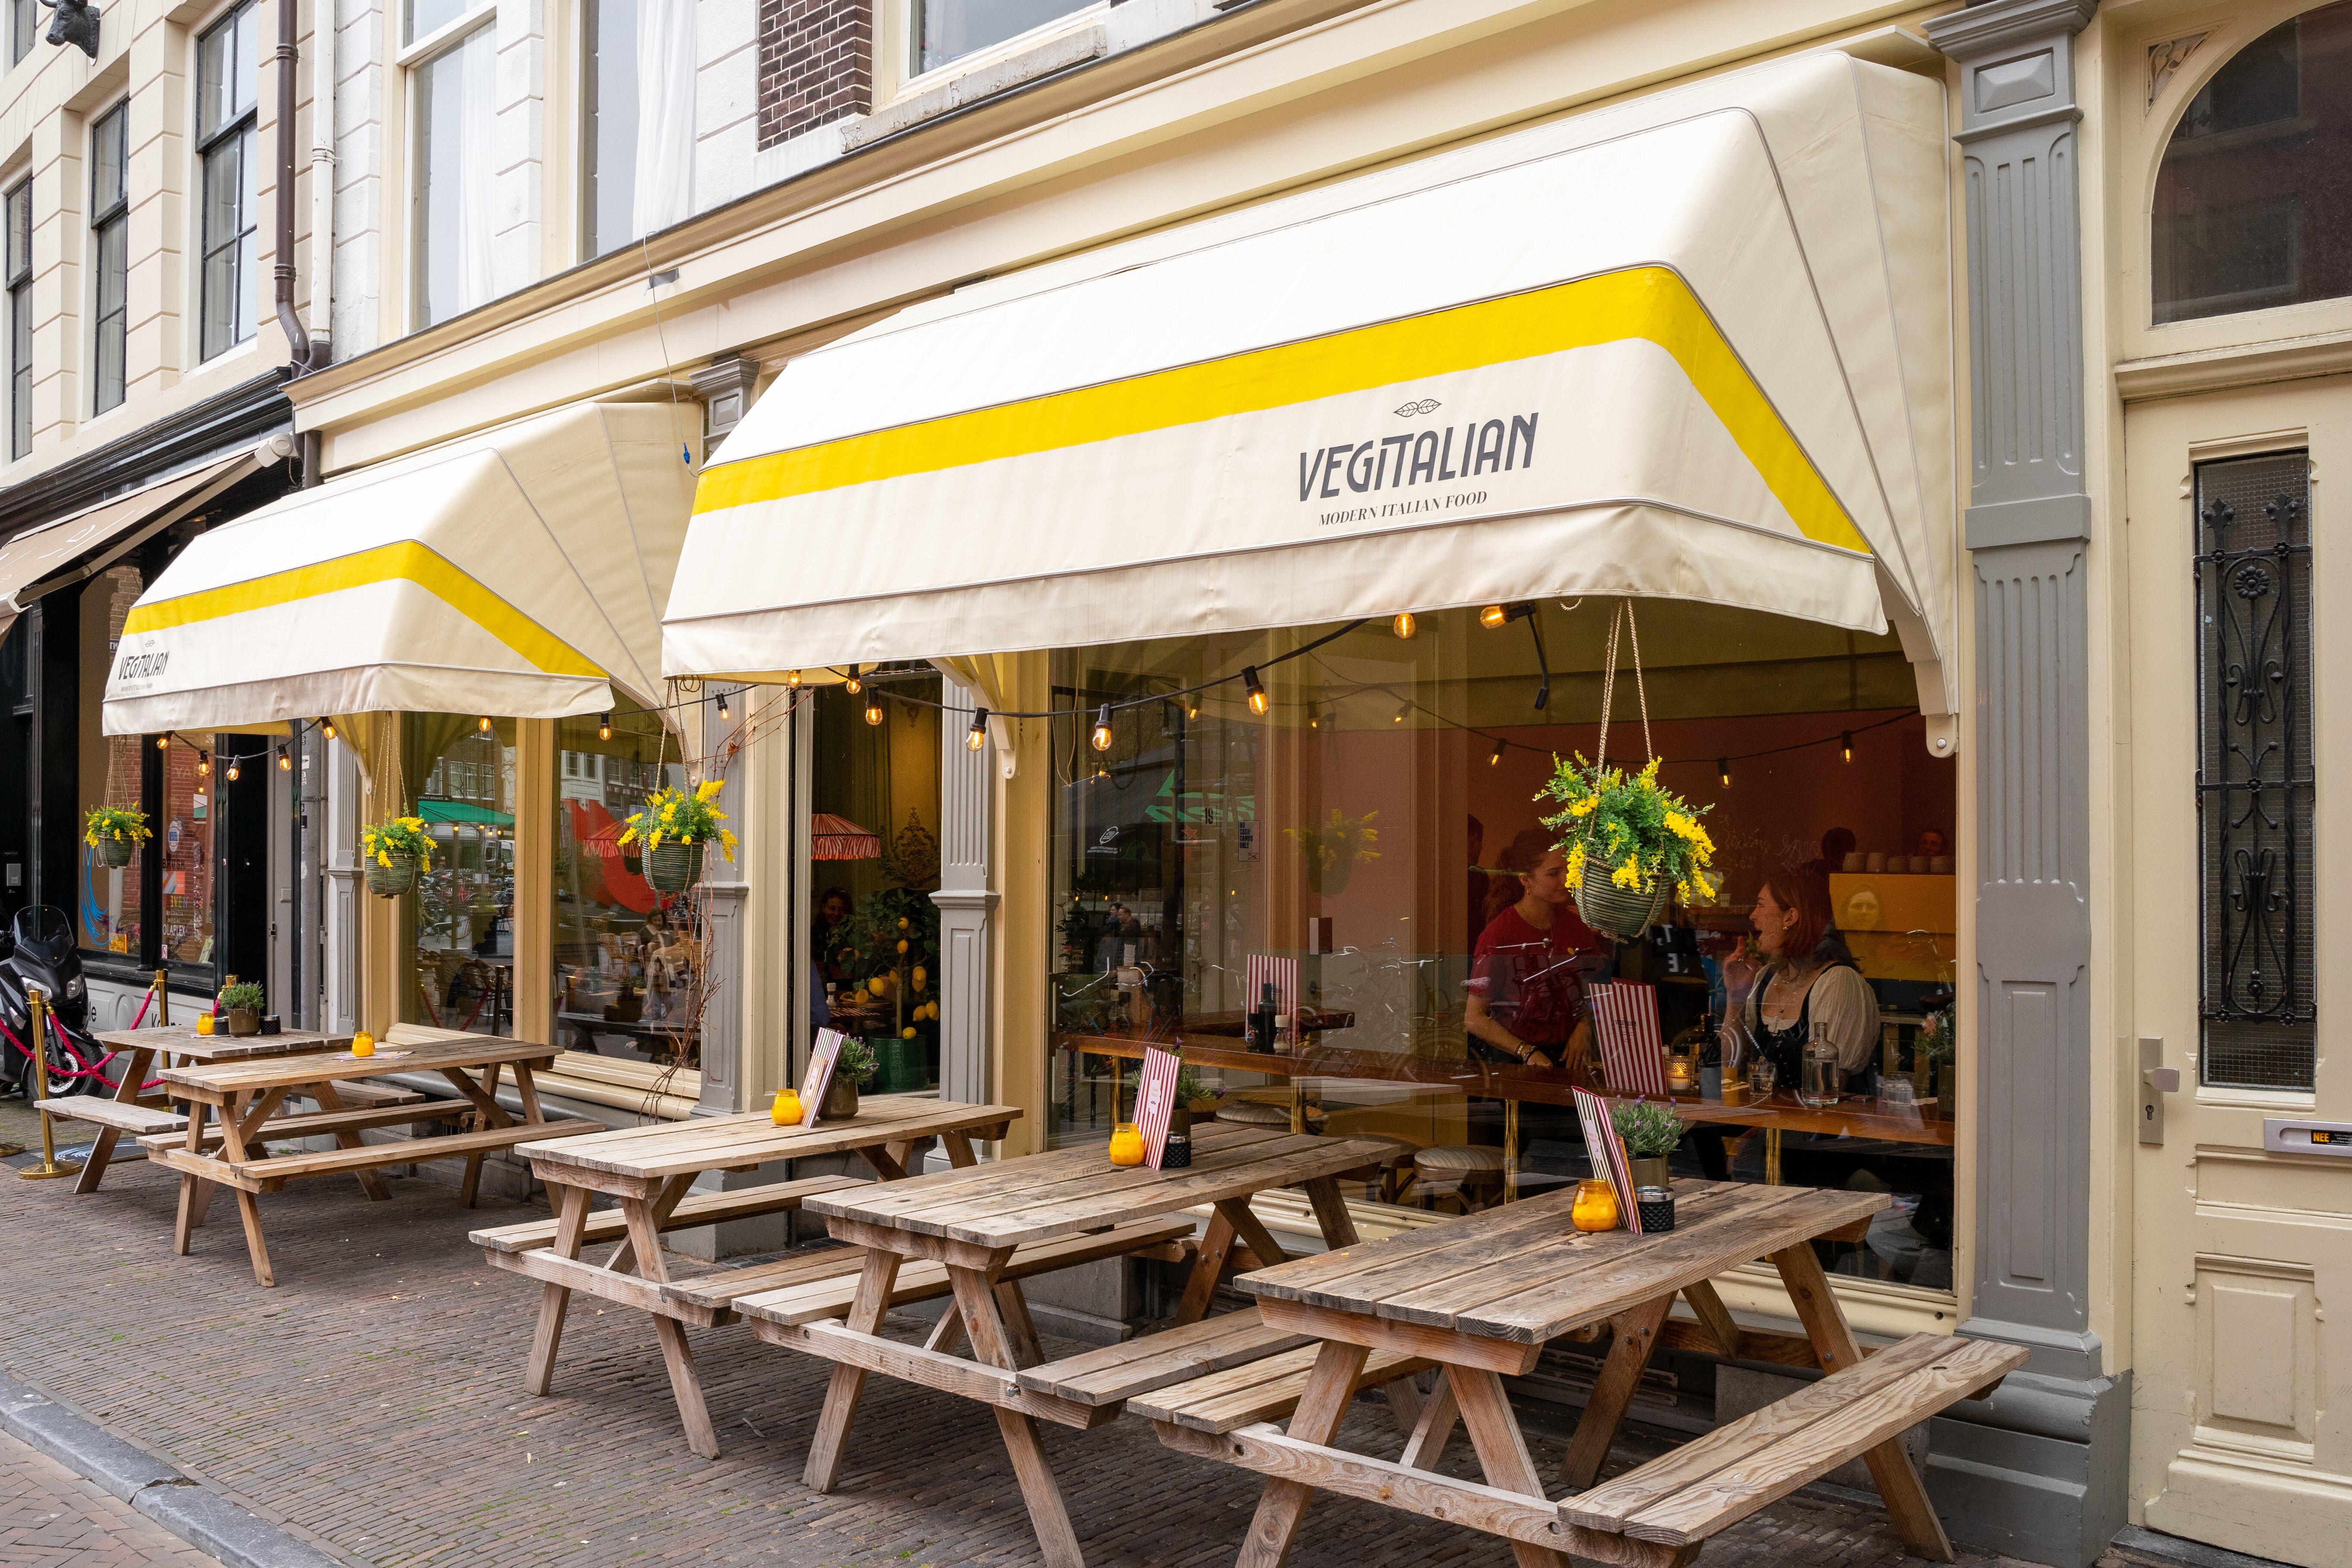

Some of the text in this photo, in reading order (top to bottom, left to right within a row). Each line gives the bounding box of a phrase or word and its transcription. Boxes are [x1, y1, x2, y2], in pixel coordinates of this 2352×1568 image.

[1318, 491, 1487, 527] MODERN ITALIAN FOOD
[162, 924, 186, 936] OLAPLEX
[2313, 1132, 2329, 1142] NEE
